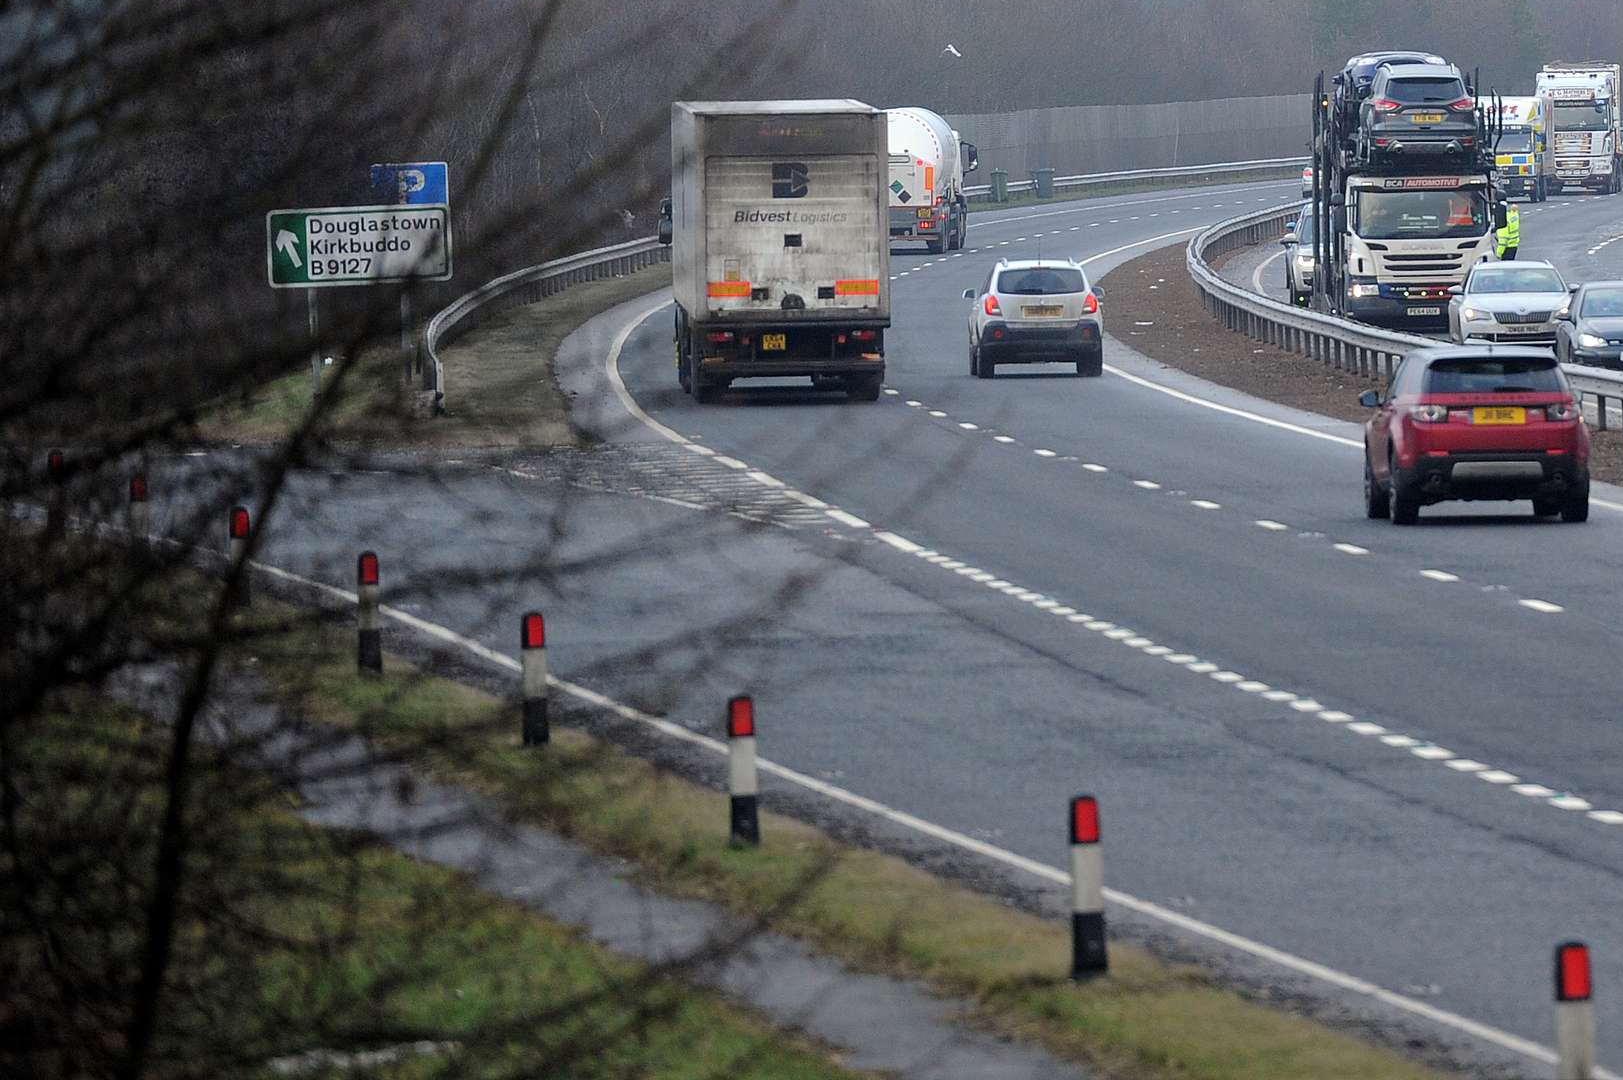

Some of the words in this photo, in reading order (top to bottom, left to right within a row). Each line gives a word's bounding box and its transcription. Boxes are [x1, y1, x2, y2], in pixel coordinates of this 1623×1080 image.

[1407, 179, 1457, 187] AUTOMOTIVE
[309, 216, 441, 235] Douglastown
[734, 210, 792, 222] Bidvest
[793, 211, 847, 225] Logistics
[310, 237, 411, 255] Kirkbuddo
